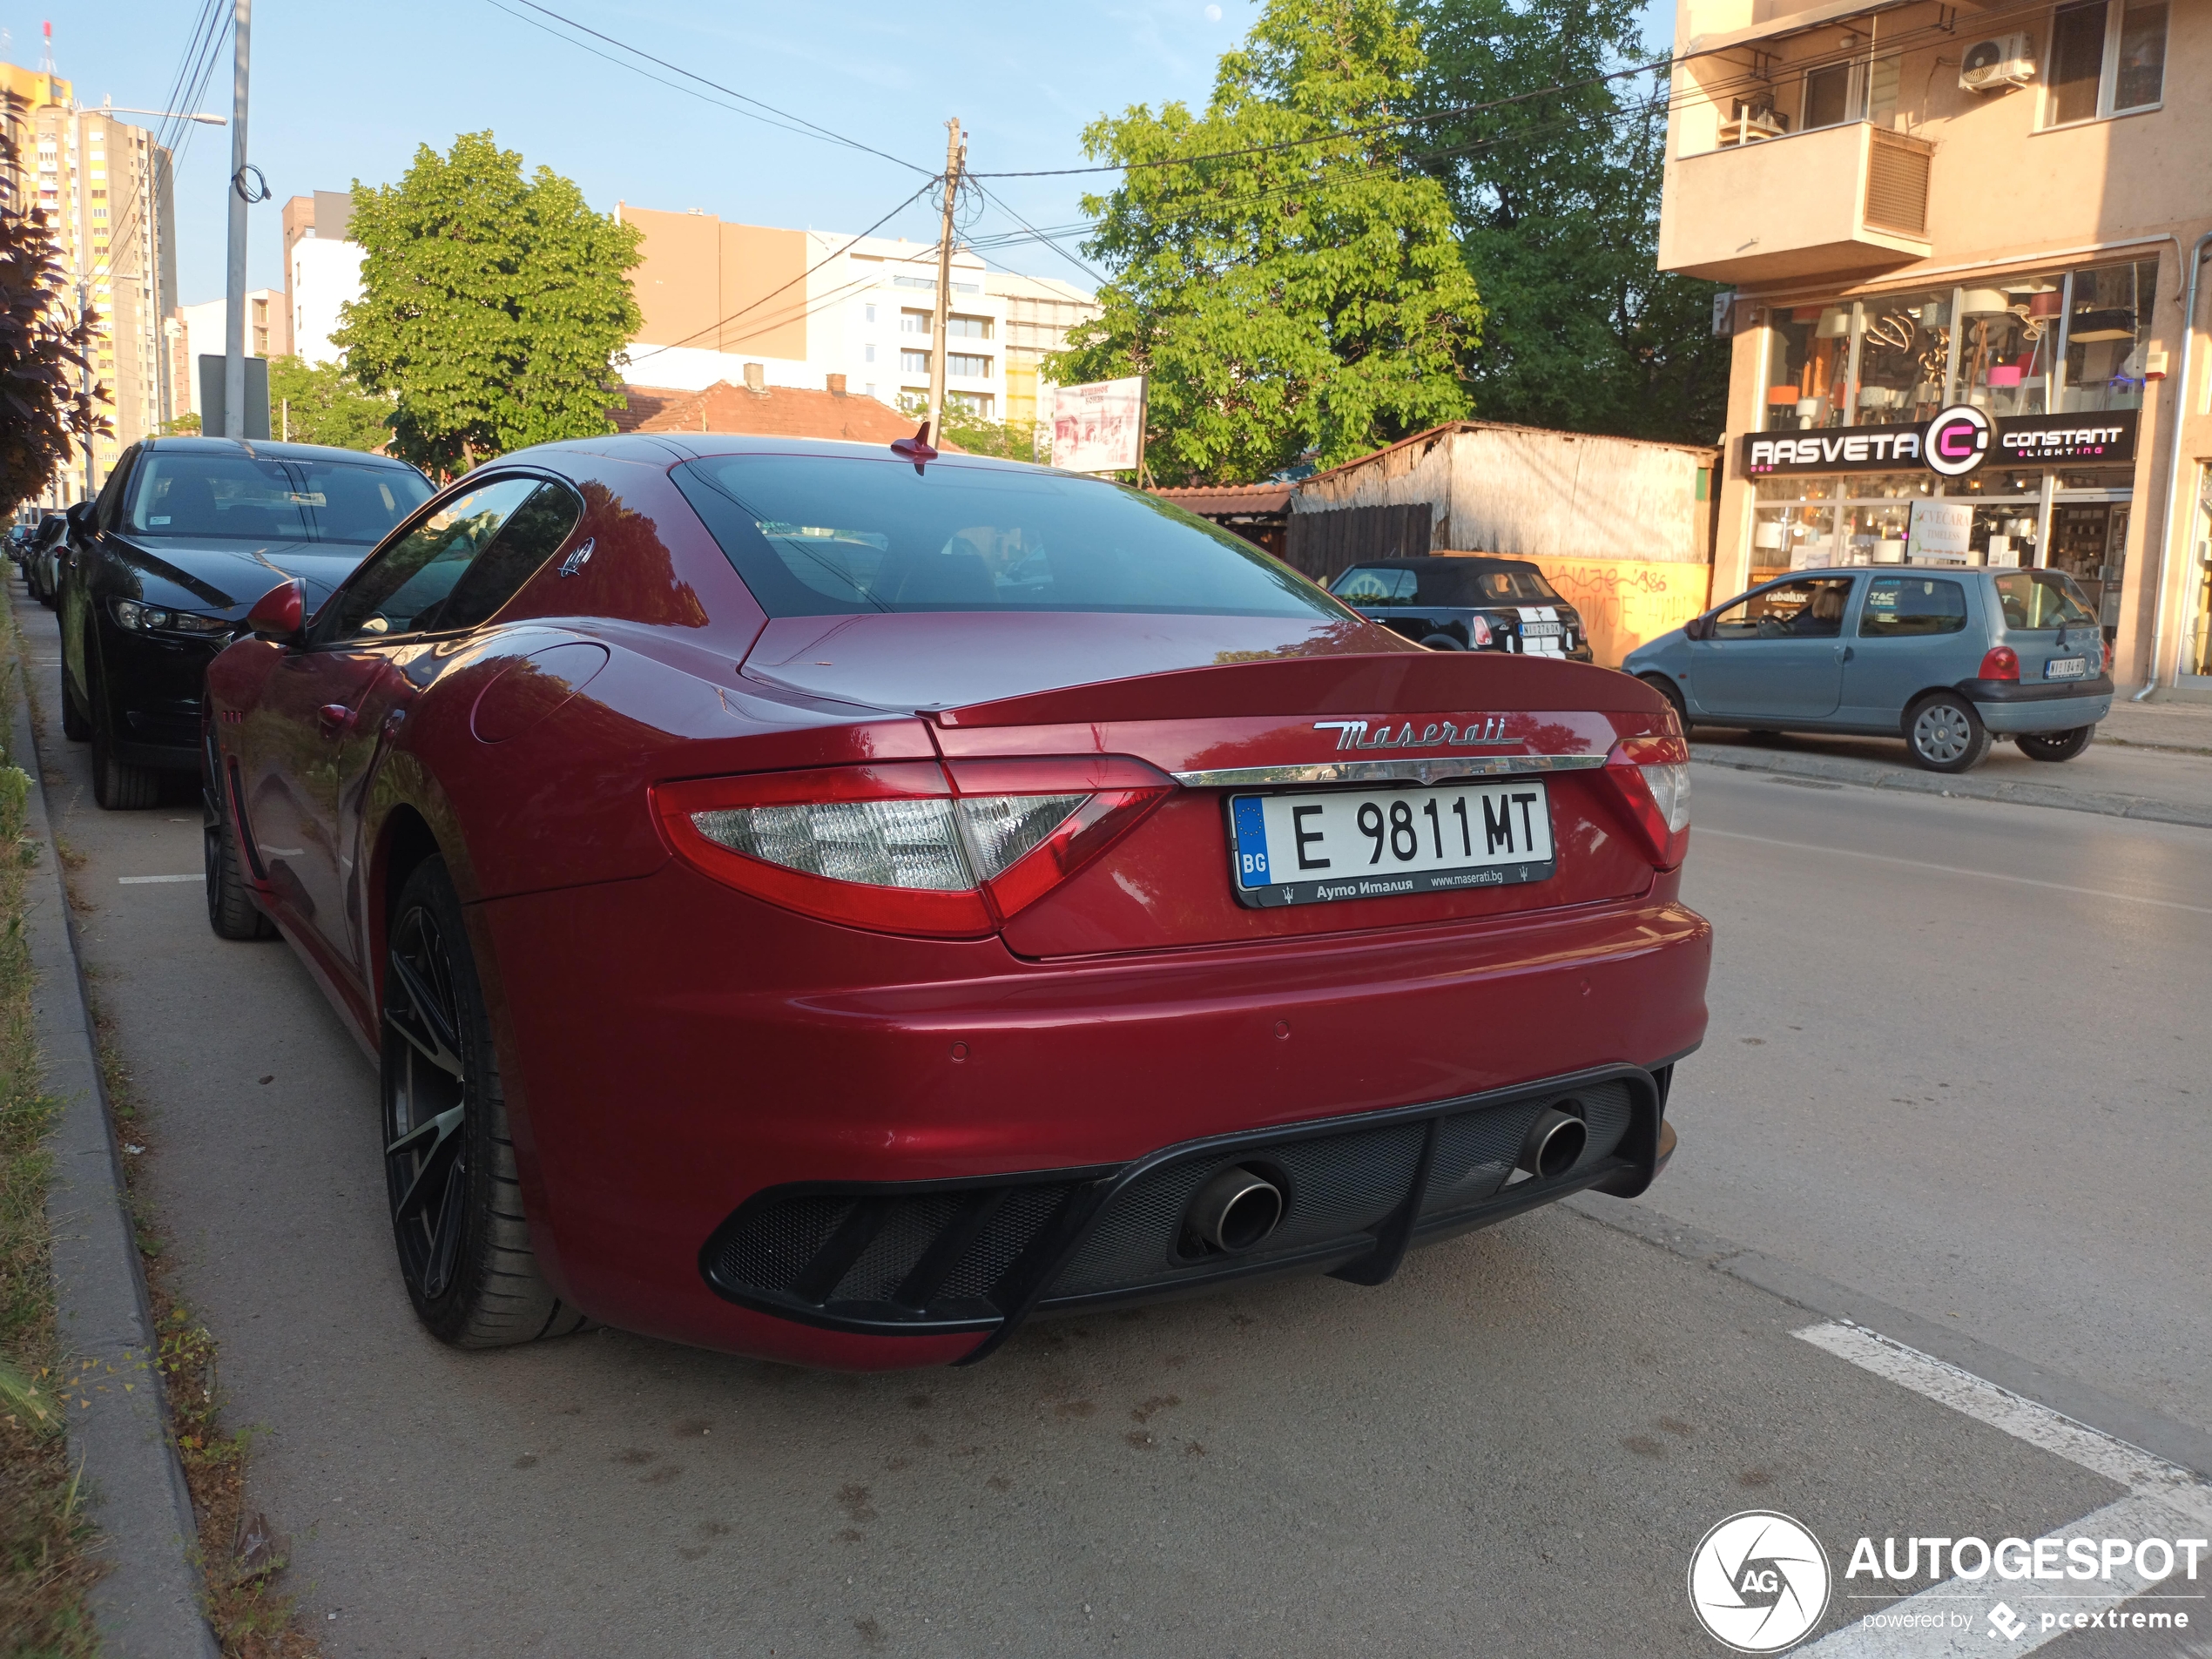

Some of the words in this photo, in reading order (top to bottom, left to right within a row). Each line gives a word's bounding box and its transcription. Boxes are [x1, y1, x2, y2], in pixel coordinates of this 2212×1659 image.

[2002, 427, 2123, 448] CONSTANT
[1750, 433, 1920, 465] RASVETA
[2026, 446, 2103, 457] LIGHTING
[1920, 508, 1971, 527] CVEĆARA
[1927, 529, 1960, 540] TIMELESS
[1765, 590, 1808, 604] rabalux
[1313, 718, 1524, 751] Maserati
[1292, 805, 1331, 870] E
[1356, 792, 1537, 865] 9811MT
[1243, 853, 1266, 873] BG
[1431, 870, 1503, 887] www.maserati.bg
